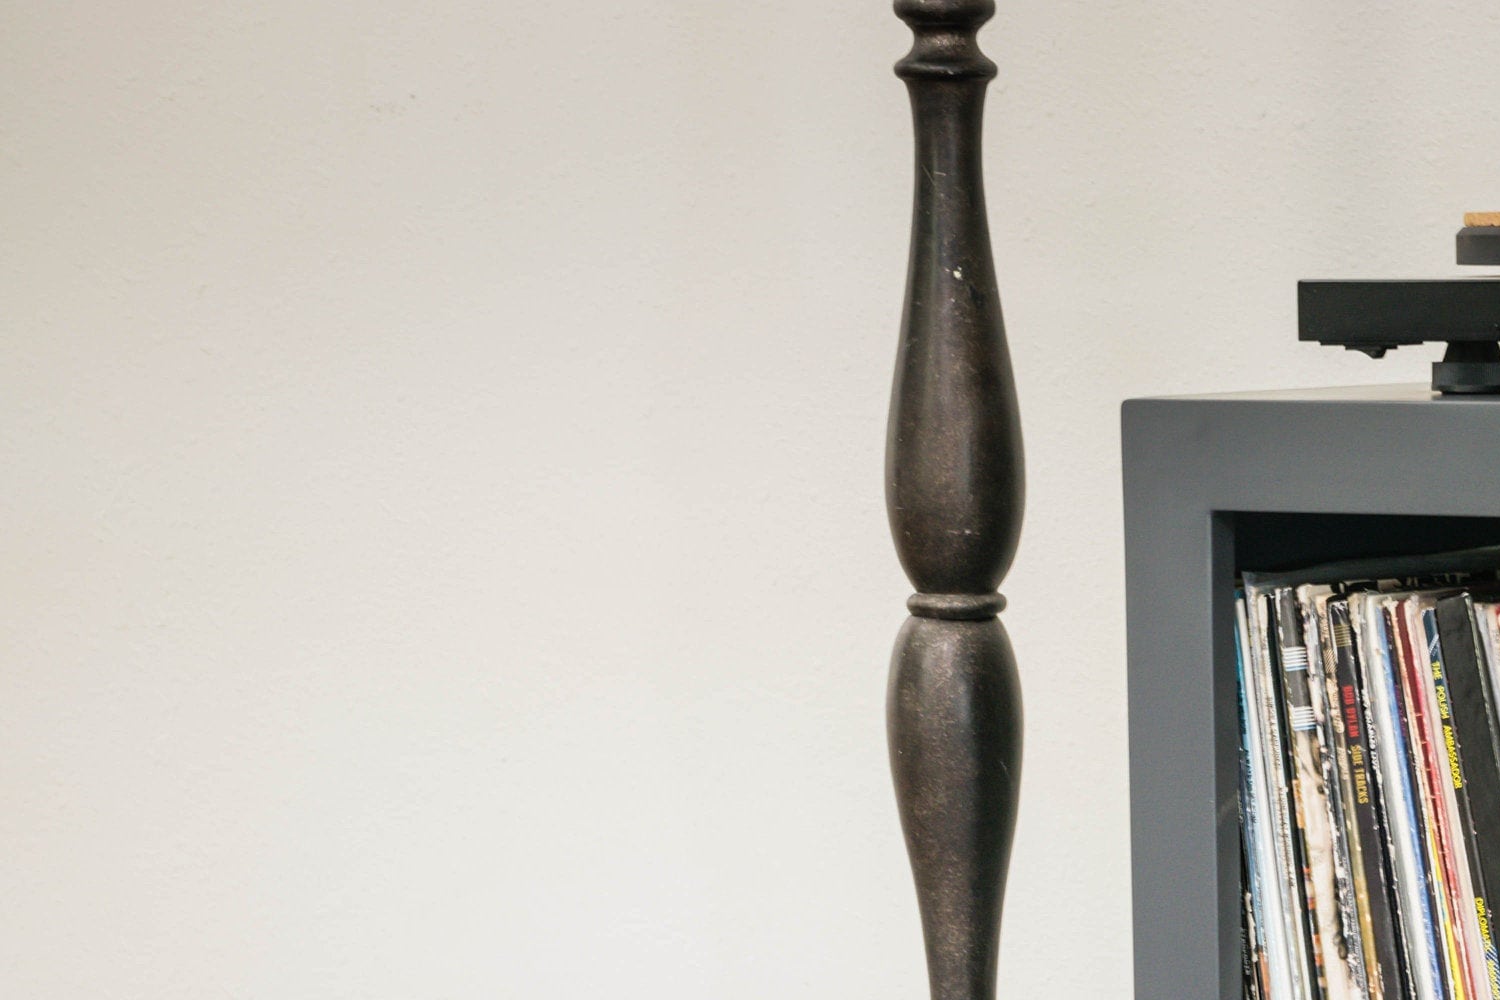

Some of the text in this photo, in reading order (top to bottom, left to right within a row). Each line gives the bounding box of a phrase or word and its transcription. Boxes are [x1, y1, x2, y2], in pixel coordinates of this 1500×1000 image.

[1343, 687, 1368, 803] BOB DYLAN SIDE TRACKS
[1431, 662, 1462, 788] THE POLISH AMBASSADOR
